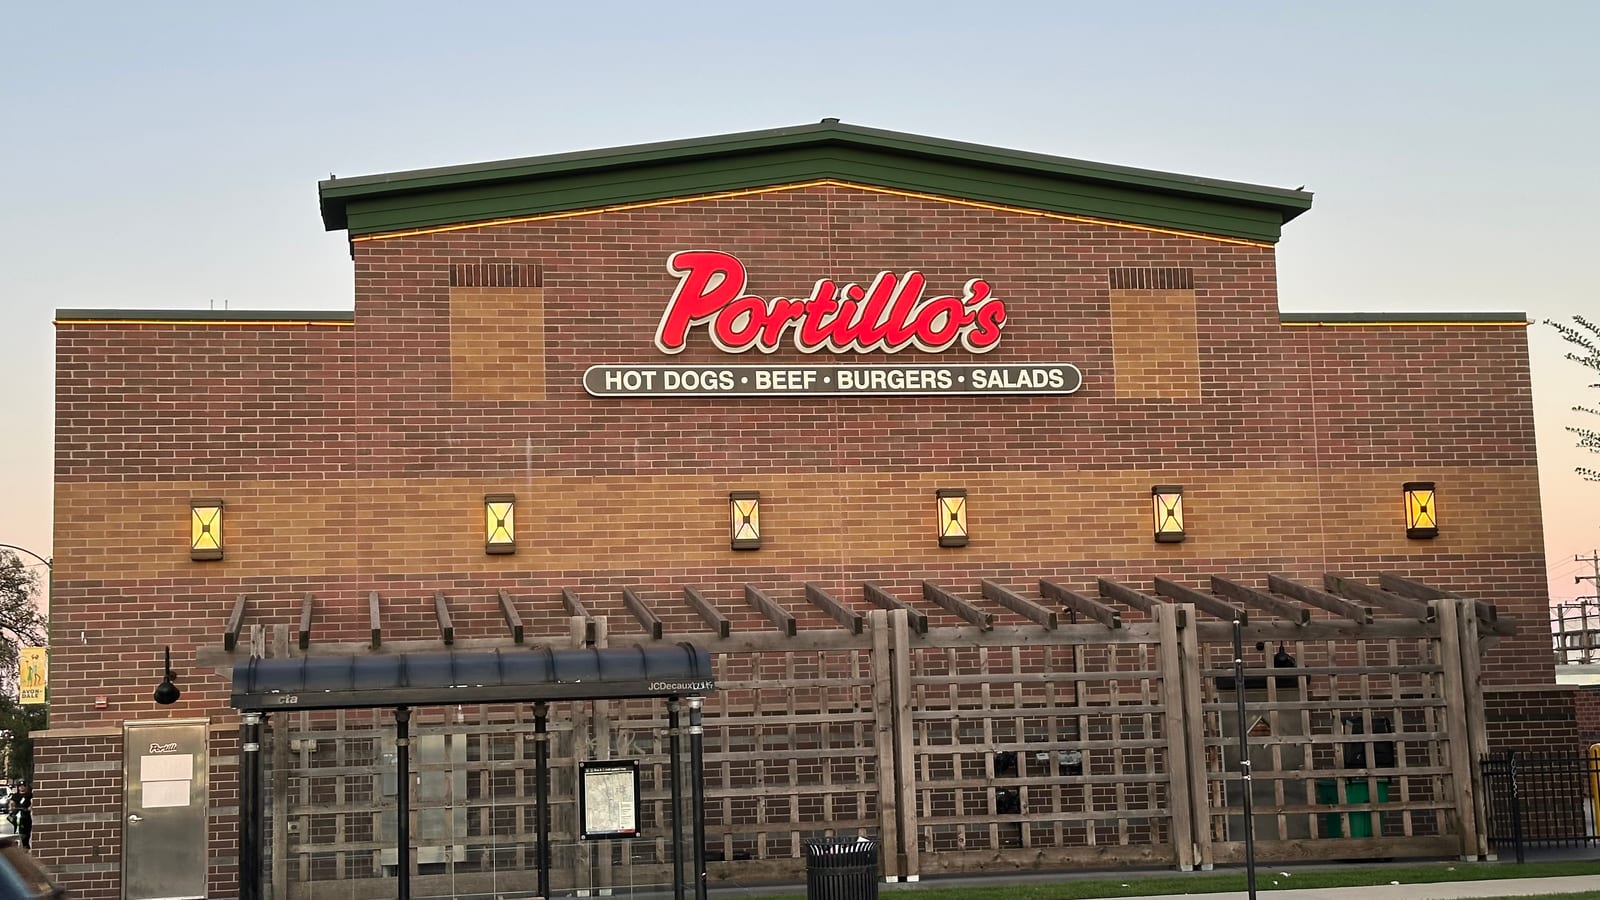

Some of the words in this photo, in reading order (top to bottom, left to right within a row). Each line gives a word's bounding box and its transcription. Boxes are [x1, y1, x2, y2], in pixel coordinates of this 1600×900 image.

[655, 249, 1008, 355] Portillo's
[605, 371, 656, 390] HOT
[664, 371, 735, 391] DOGS
[755, 370, 817, 390] BEEF
[837, 370, 952, 390] BURGERS
[972, 369, 1064, 389] SALADS
[648, 681, 693, 691] JCDecaux
[279, 694, 298, 705] cta
